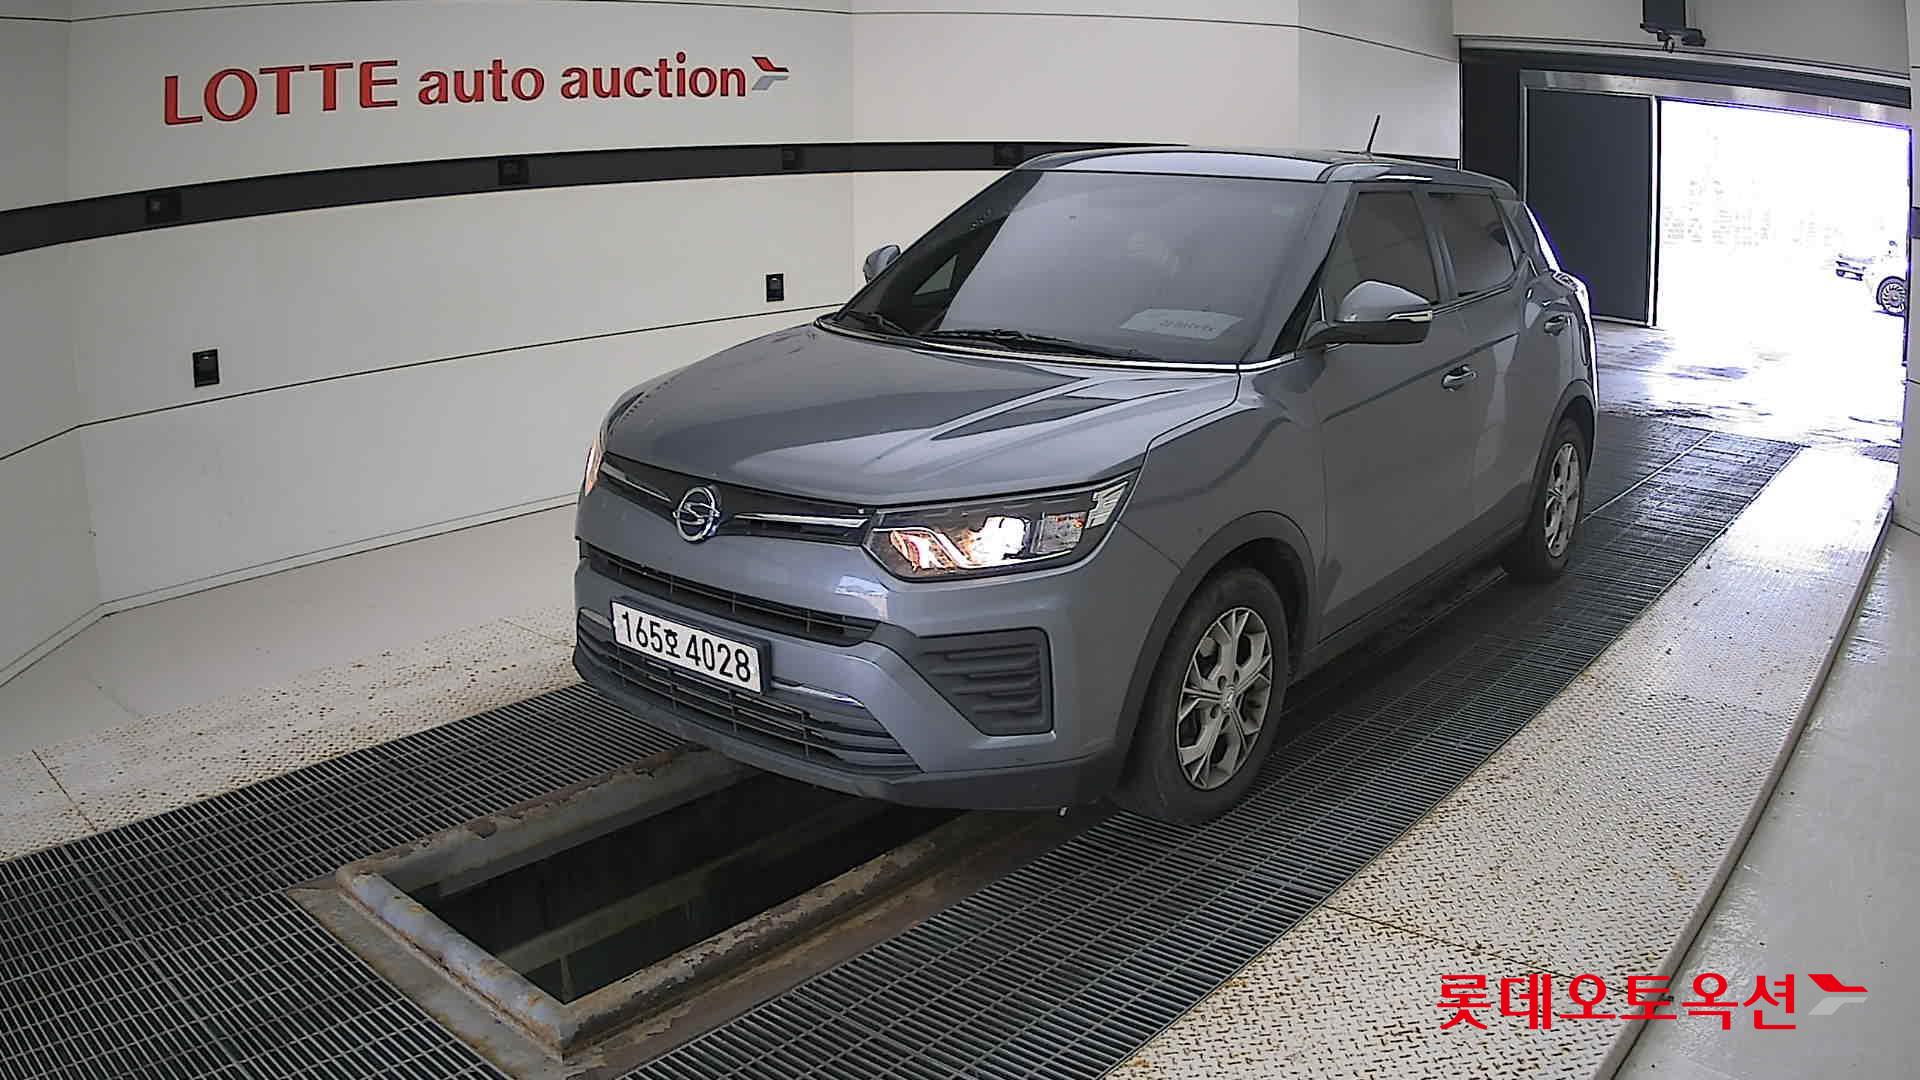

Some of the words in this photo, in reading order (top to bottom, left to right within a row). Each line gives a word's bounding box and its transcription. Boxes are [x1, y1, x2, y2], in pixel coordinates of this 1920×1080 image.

[164, 59, 398, 126] LOTTE
[418, 60, 545, 104] auto
[560, 52, 747, 100] auction
